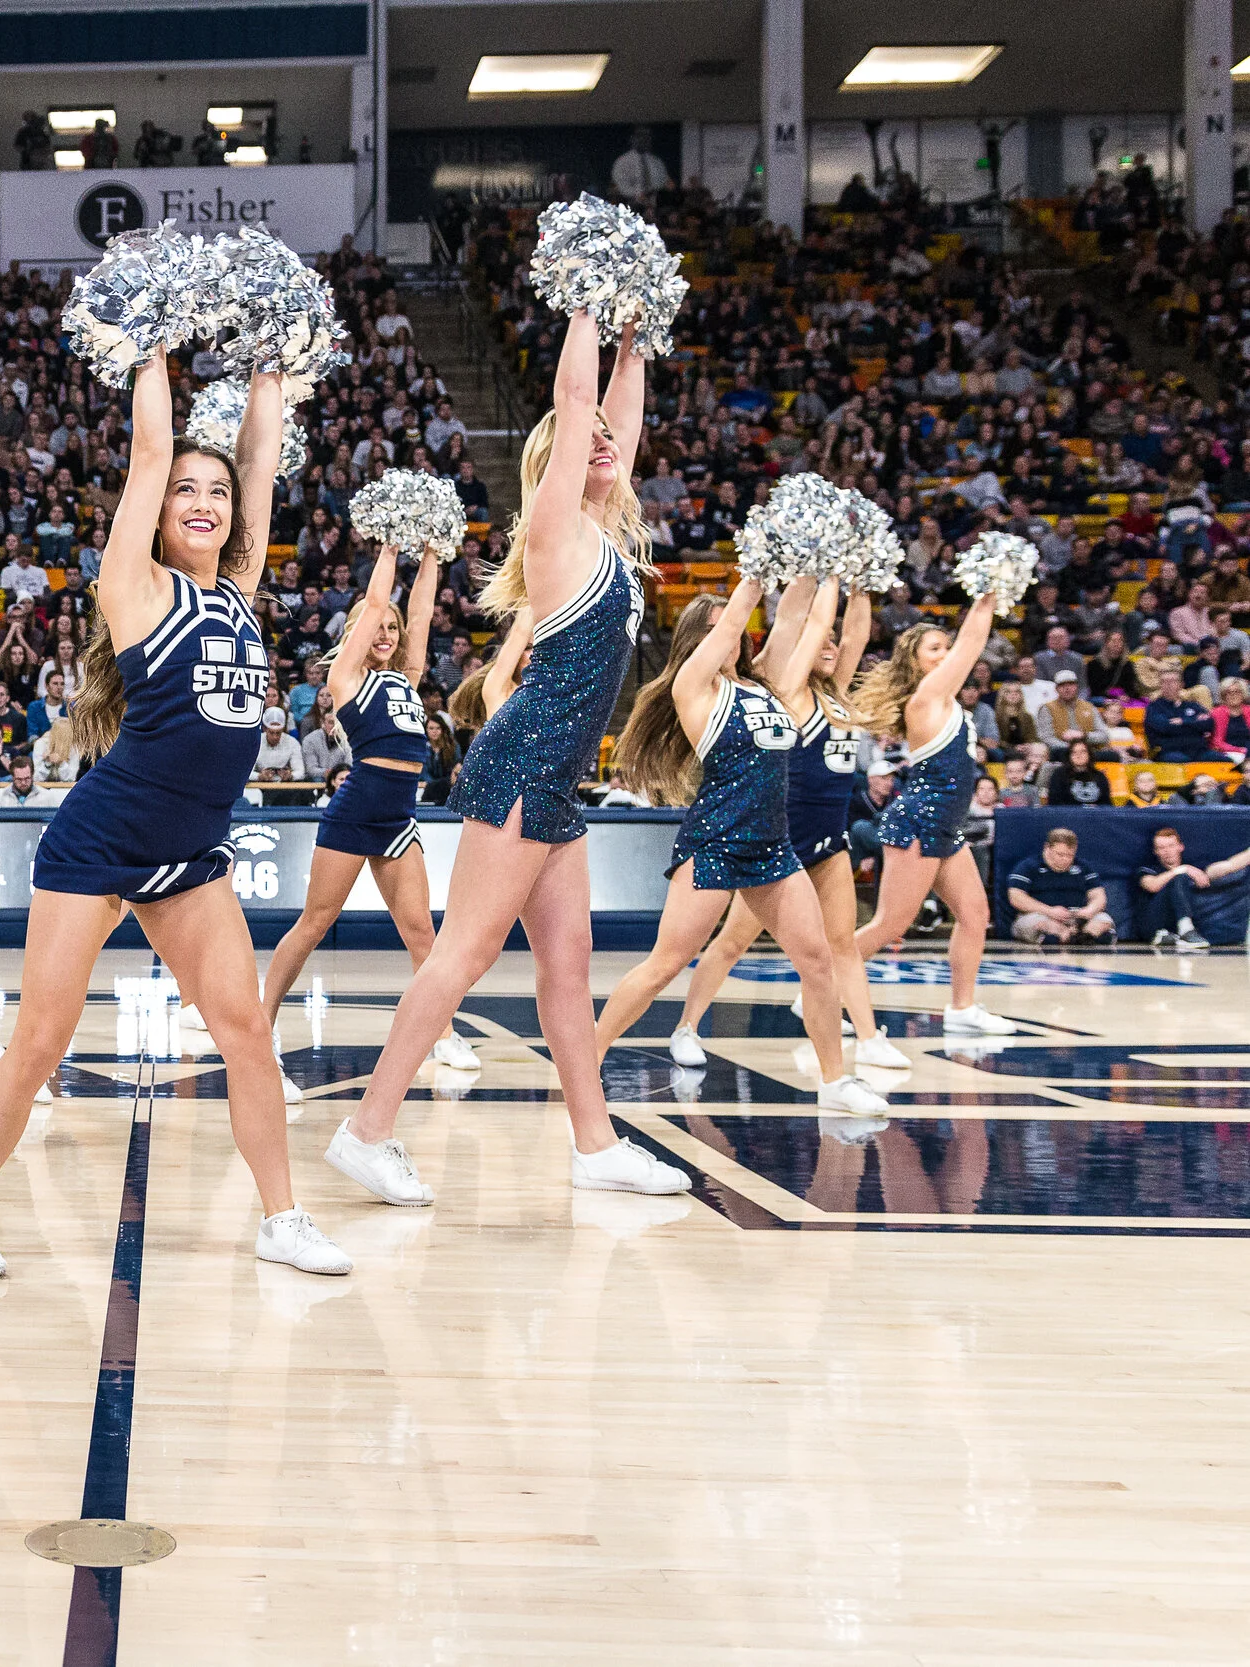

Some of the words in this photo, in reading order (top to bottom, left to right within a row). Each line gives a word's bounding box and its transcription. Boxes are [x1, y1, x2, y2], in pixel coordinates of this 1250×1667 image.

[776, 124, 796, 141] M
[1207, 114, 1224, 133] N
[95, 196, 127, 238] F
[157, 187, 276, 224] Fisher
[192, 664, 271, 697] STATE
[387, 700, 427, 723] STATE
[232, 860, 279, 900] 46
